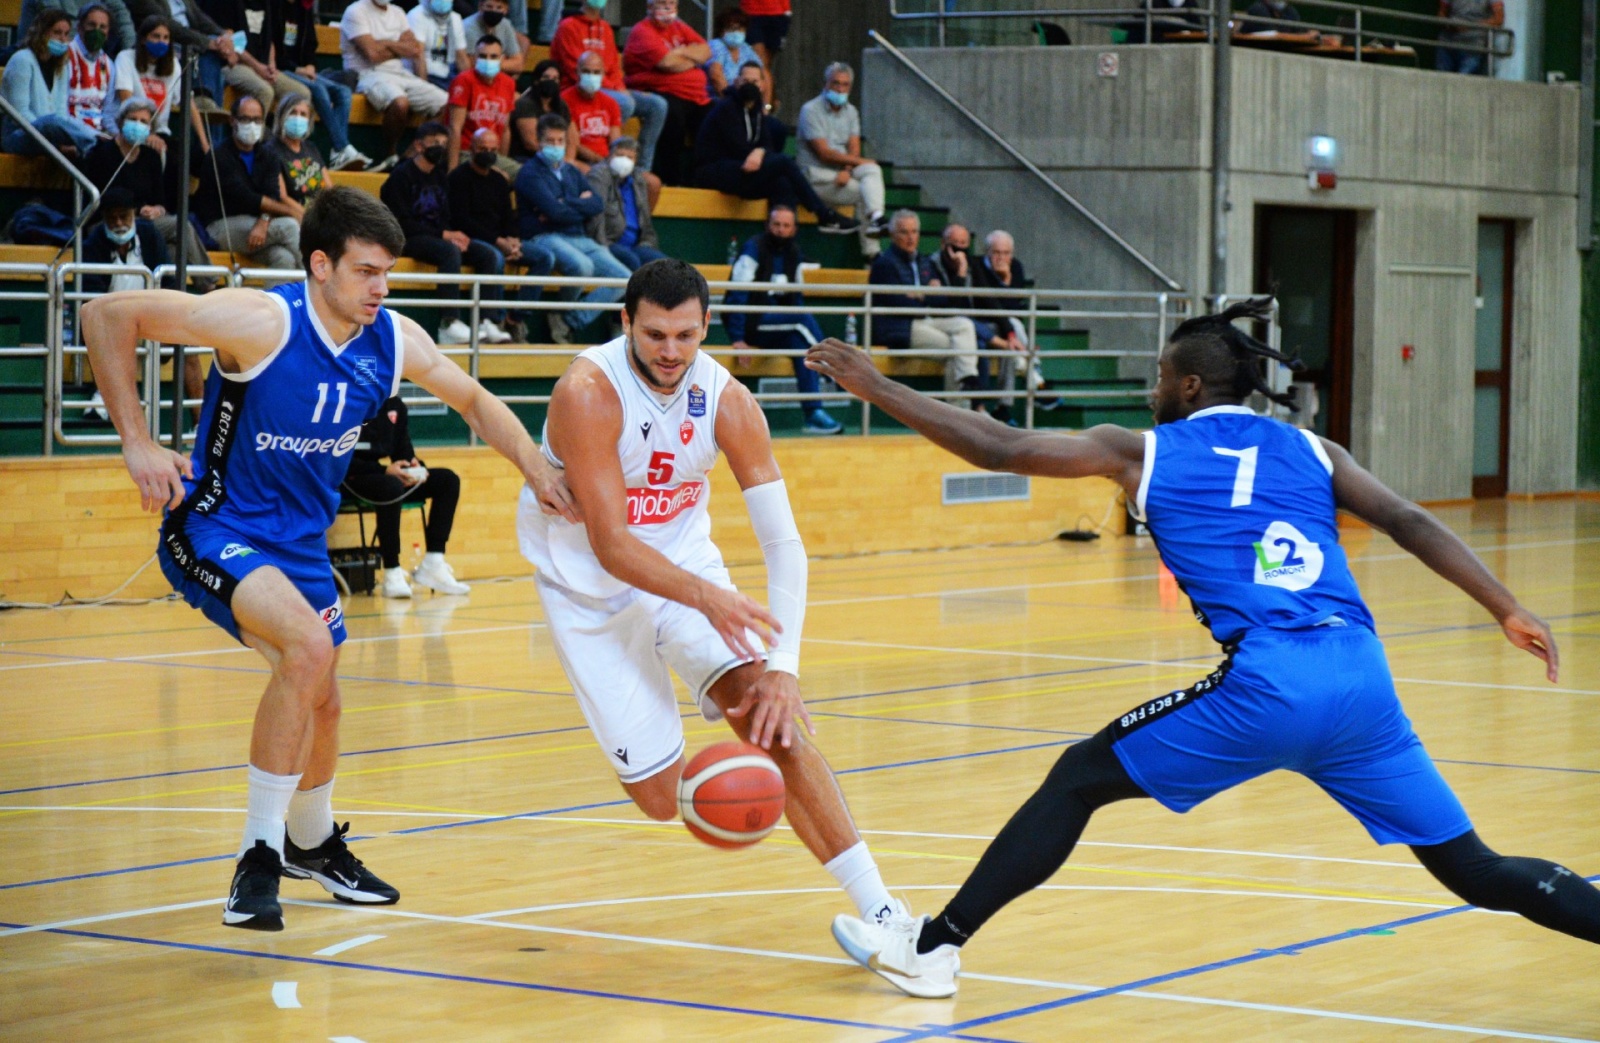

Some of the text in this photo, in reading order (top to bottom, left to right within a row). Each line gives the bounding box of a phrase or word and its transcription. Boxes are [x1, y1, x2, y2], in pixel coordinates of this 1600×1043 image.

[311, 382, 348, 423] 11
[647, 451, 675, 485] 5
[1212, 446, 1258, 507] 7
[1252, 537, 1305, 571] L2
[1264, 565, 1306, 580] ROMONT
[1121, 696, 1172, 728] BCF FKB
